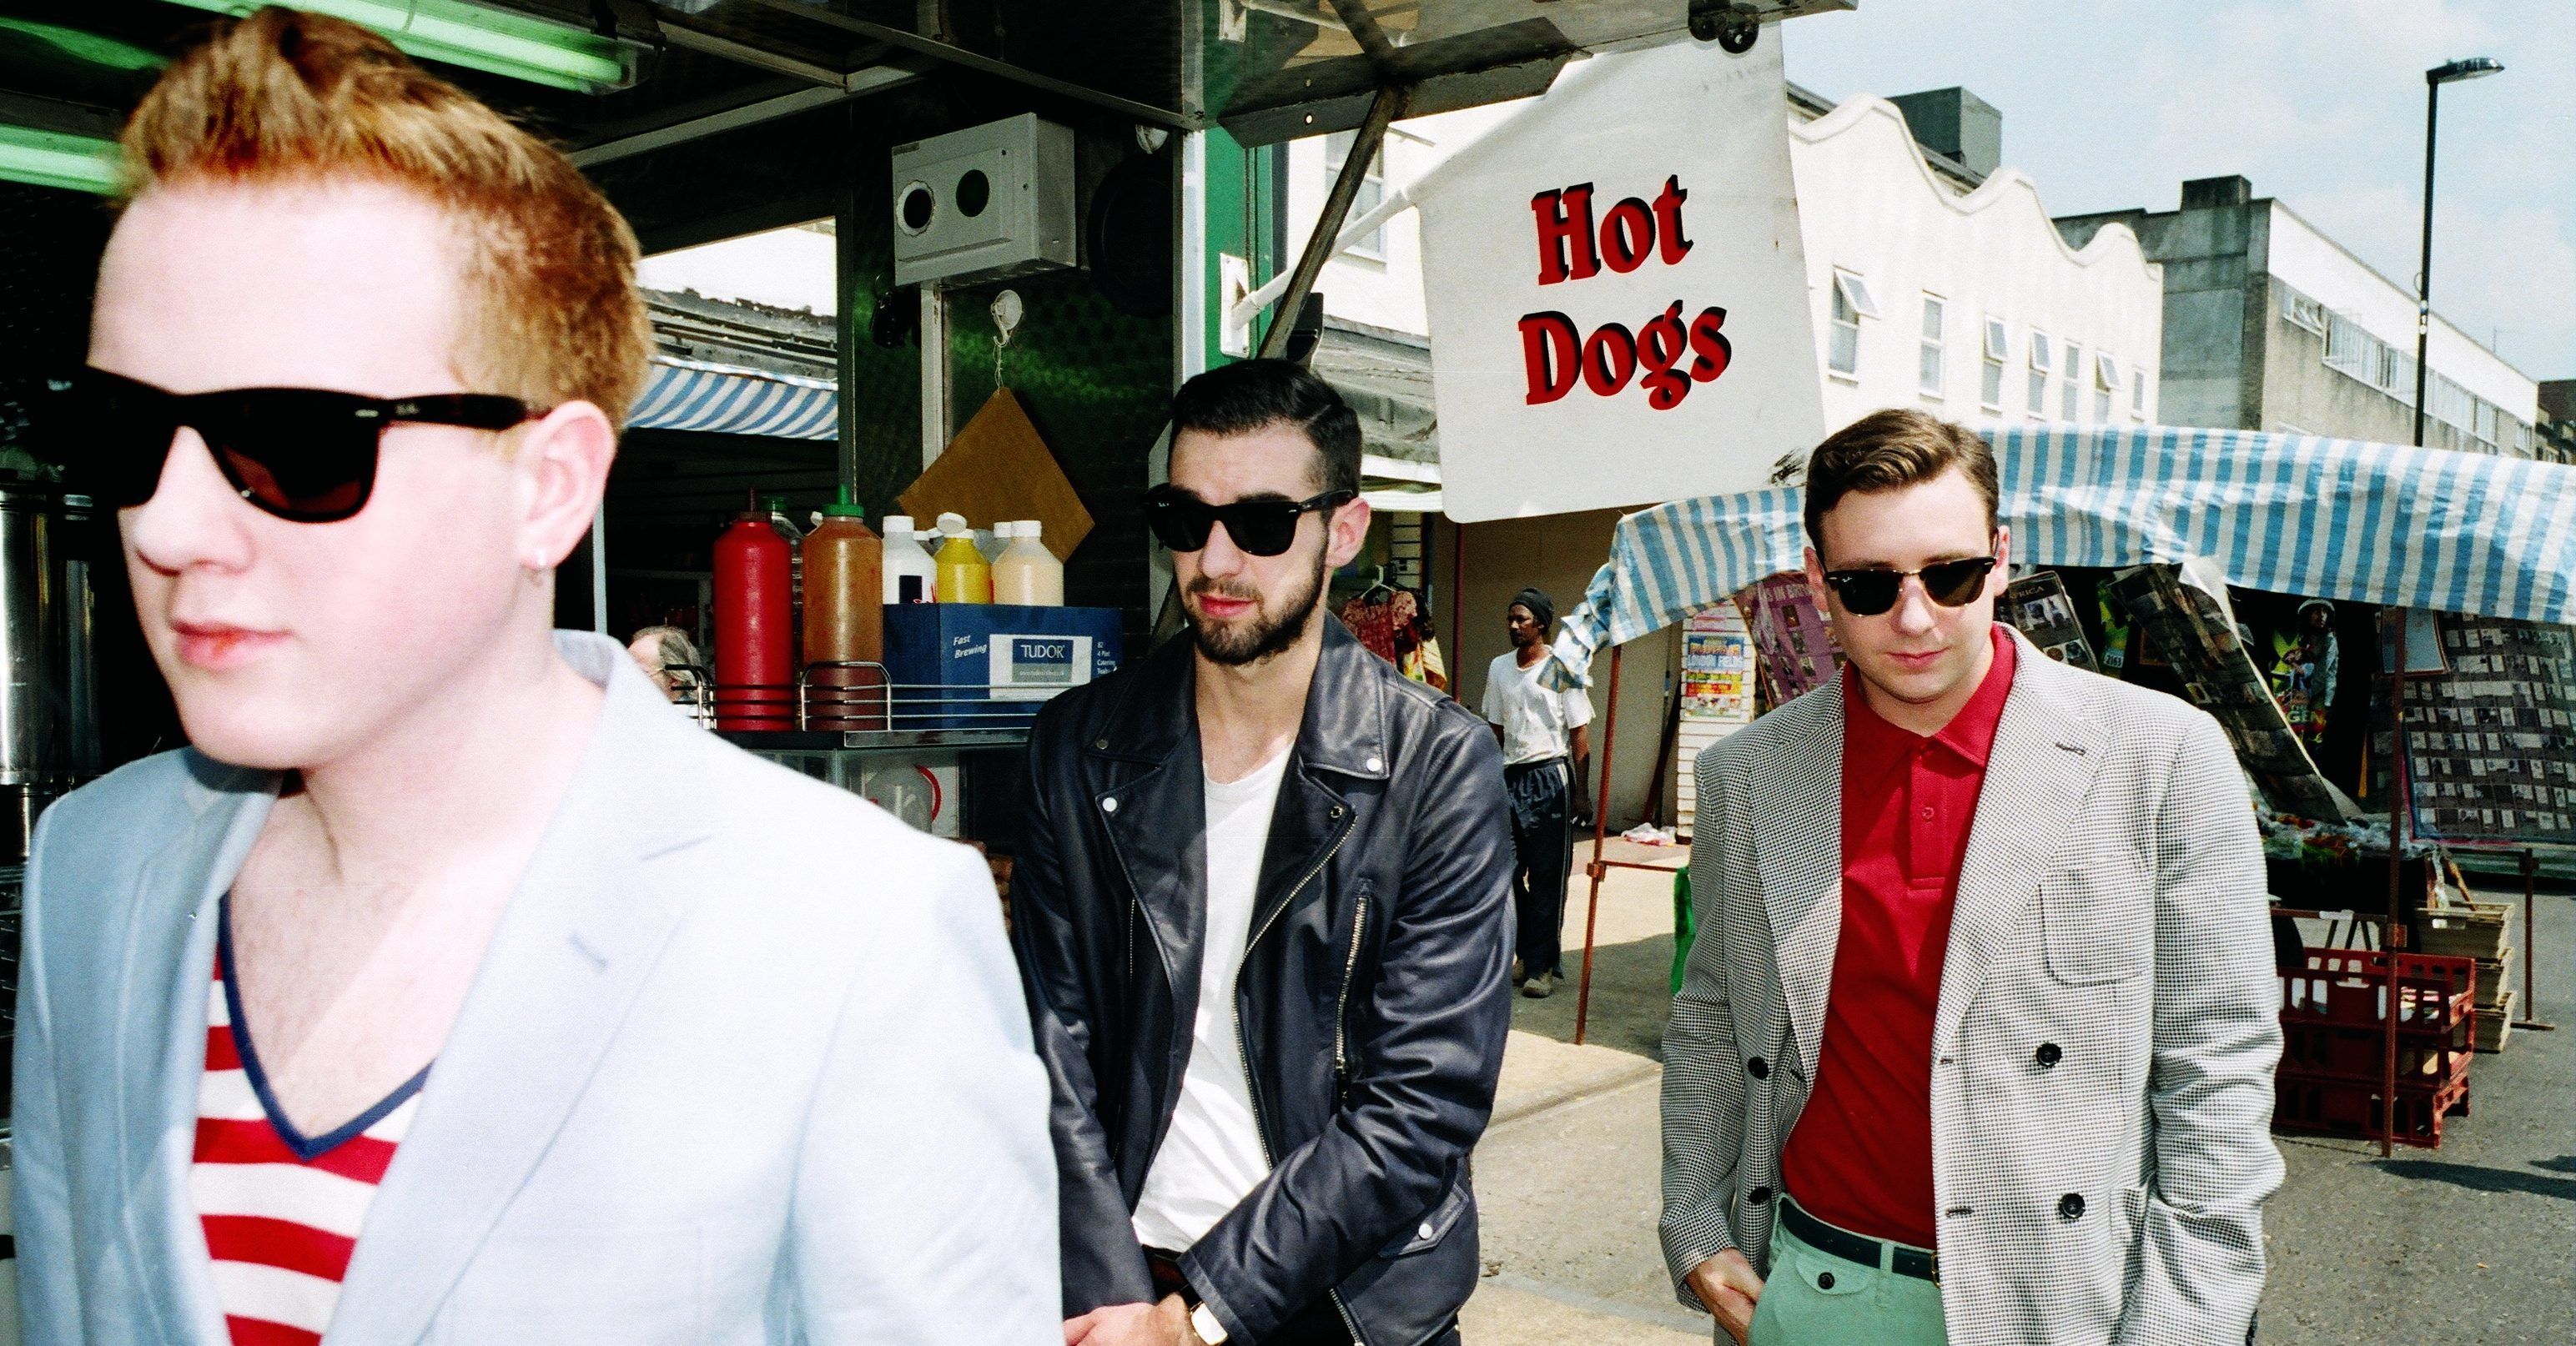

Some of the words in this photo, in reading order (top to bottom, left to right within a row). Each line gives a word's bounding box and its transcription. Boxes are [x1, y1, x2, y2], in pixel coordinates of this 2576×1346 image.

[1531, 174, 1693, 285] Hot
[1518, 299, 1732, 410] Dogs
[953, 635, 971, 646] Fast
[954, 644, 987, 659] Brewing
